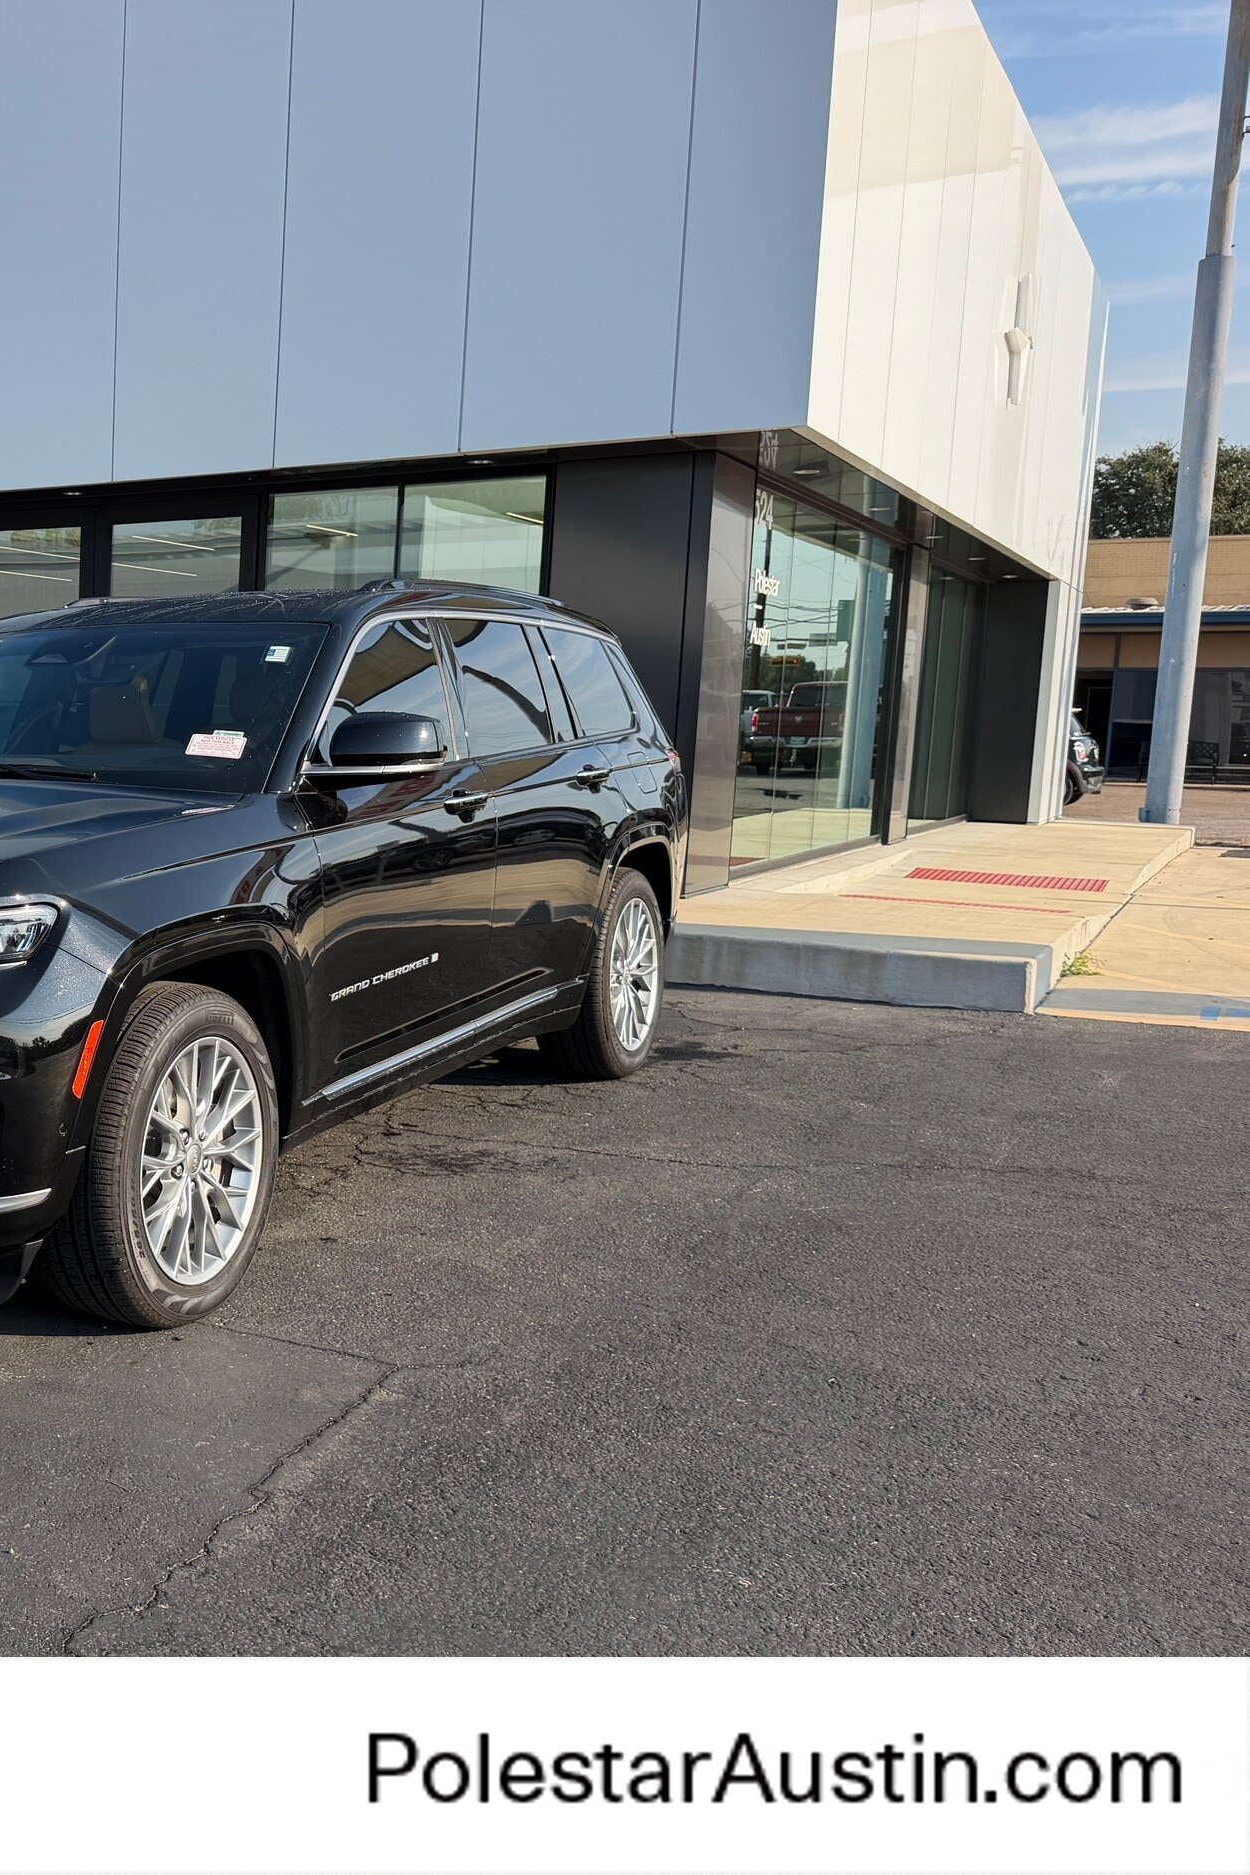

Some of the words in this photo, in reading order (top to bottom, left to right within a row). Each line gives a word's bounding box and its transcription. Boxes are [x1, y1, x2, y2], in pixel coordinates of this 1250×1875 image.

[754, 568, 781, 597] Polestar
[750, 621, 771, 647] Austin
[330, 979, 370, 1002] GRAND
[371, 957, 430, 985] CHEROKEE
